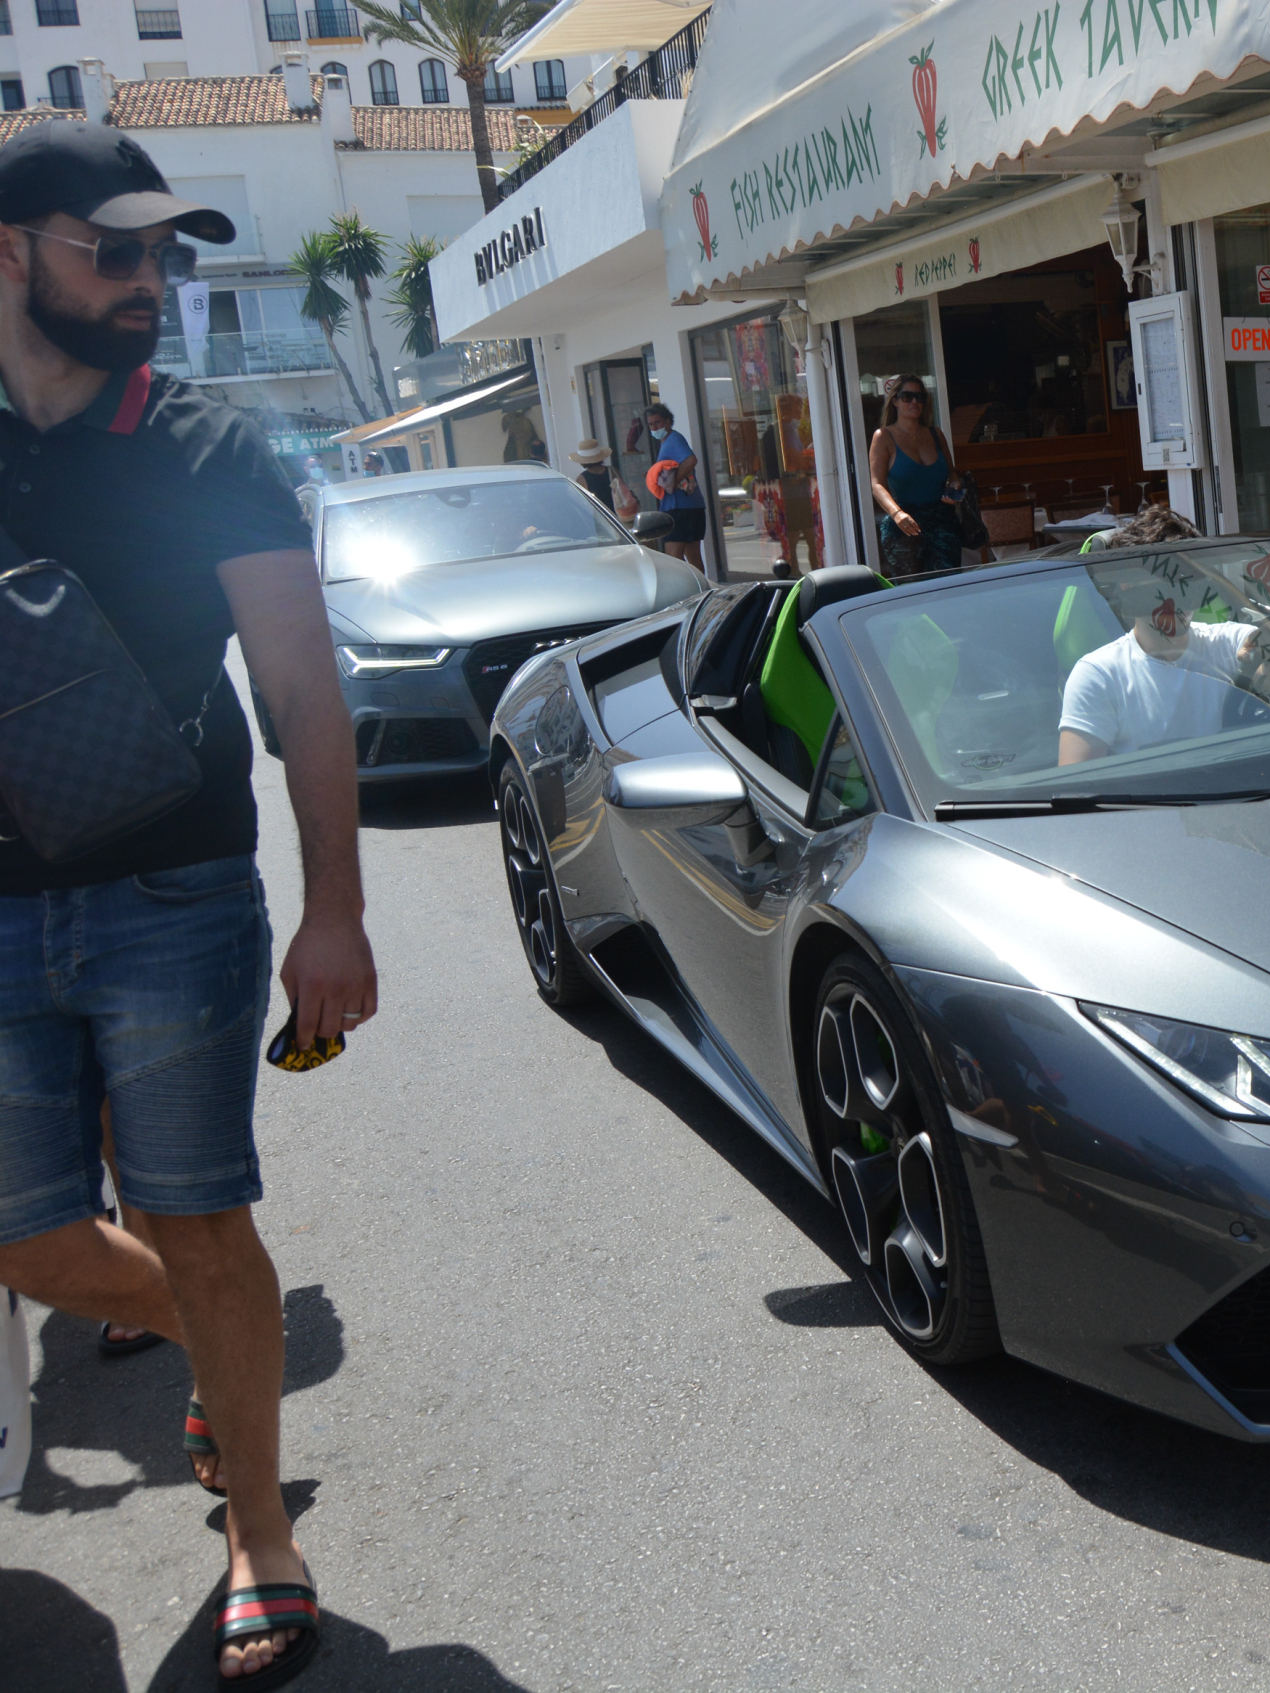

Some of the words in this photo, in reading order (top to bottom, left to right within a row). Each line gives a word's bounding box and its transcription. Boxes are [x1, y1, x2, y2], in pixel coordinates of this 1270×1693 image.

[982, 0, 1063, 123] GREEK
[730, 177, 764, 240] FISH
[762, 102, 881, 220] RESTAURANT
[474, 207, 546, 287] BVLGARI
[914, 261, 930, 288] RED
[300, 436, 335, 451] ATM
[348, 450, 358, 474] ATM
